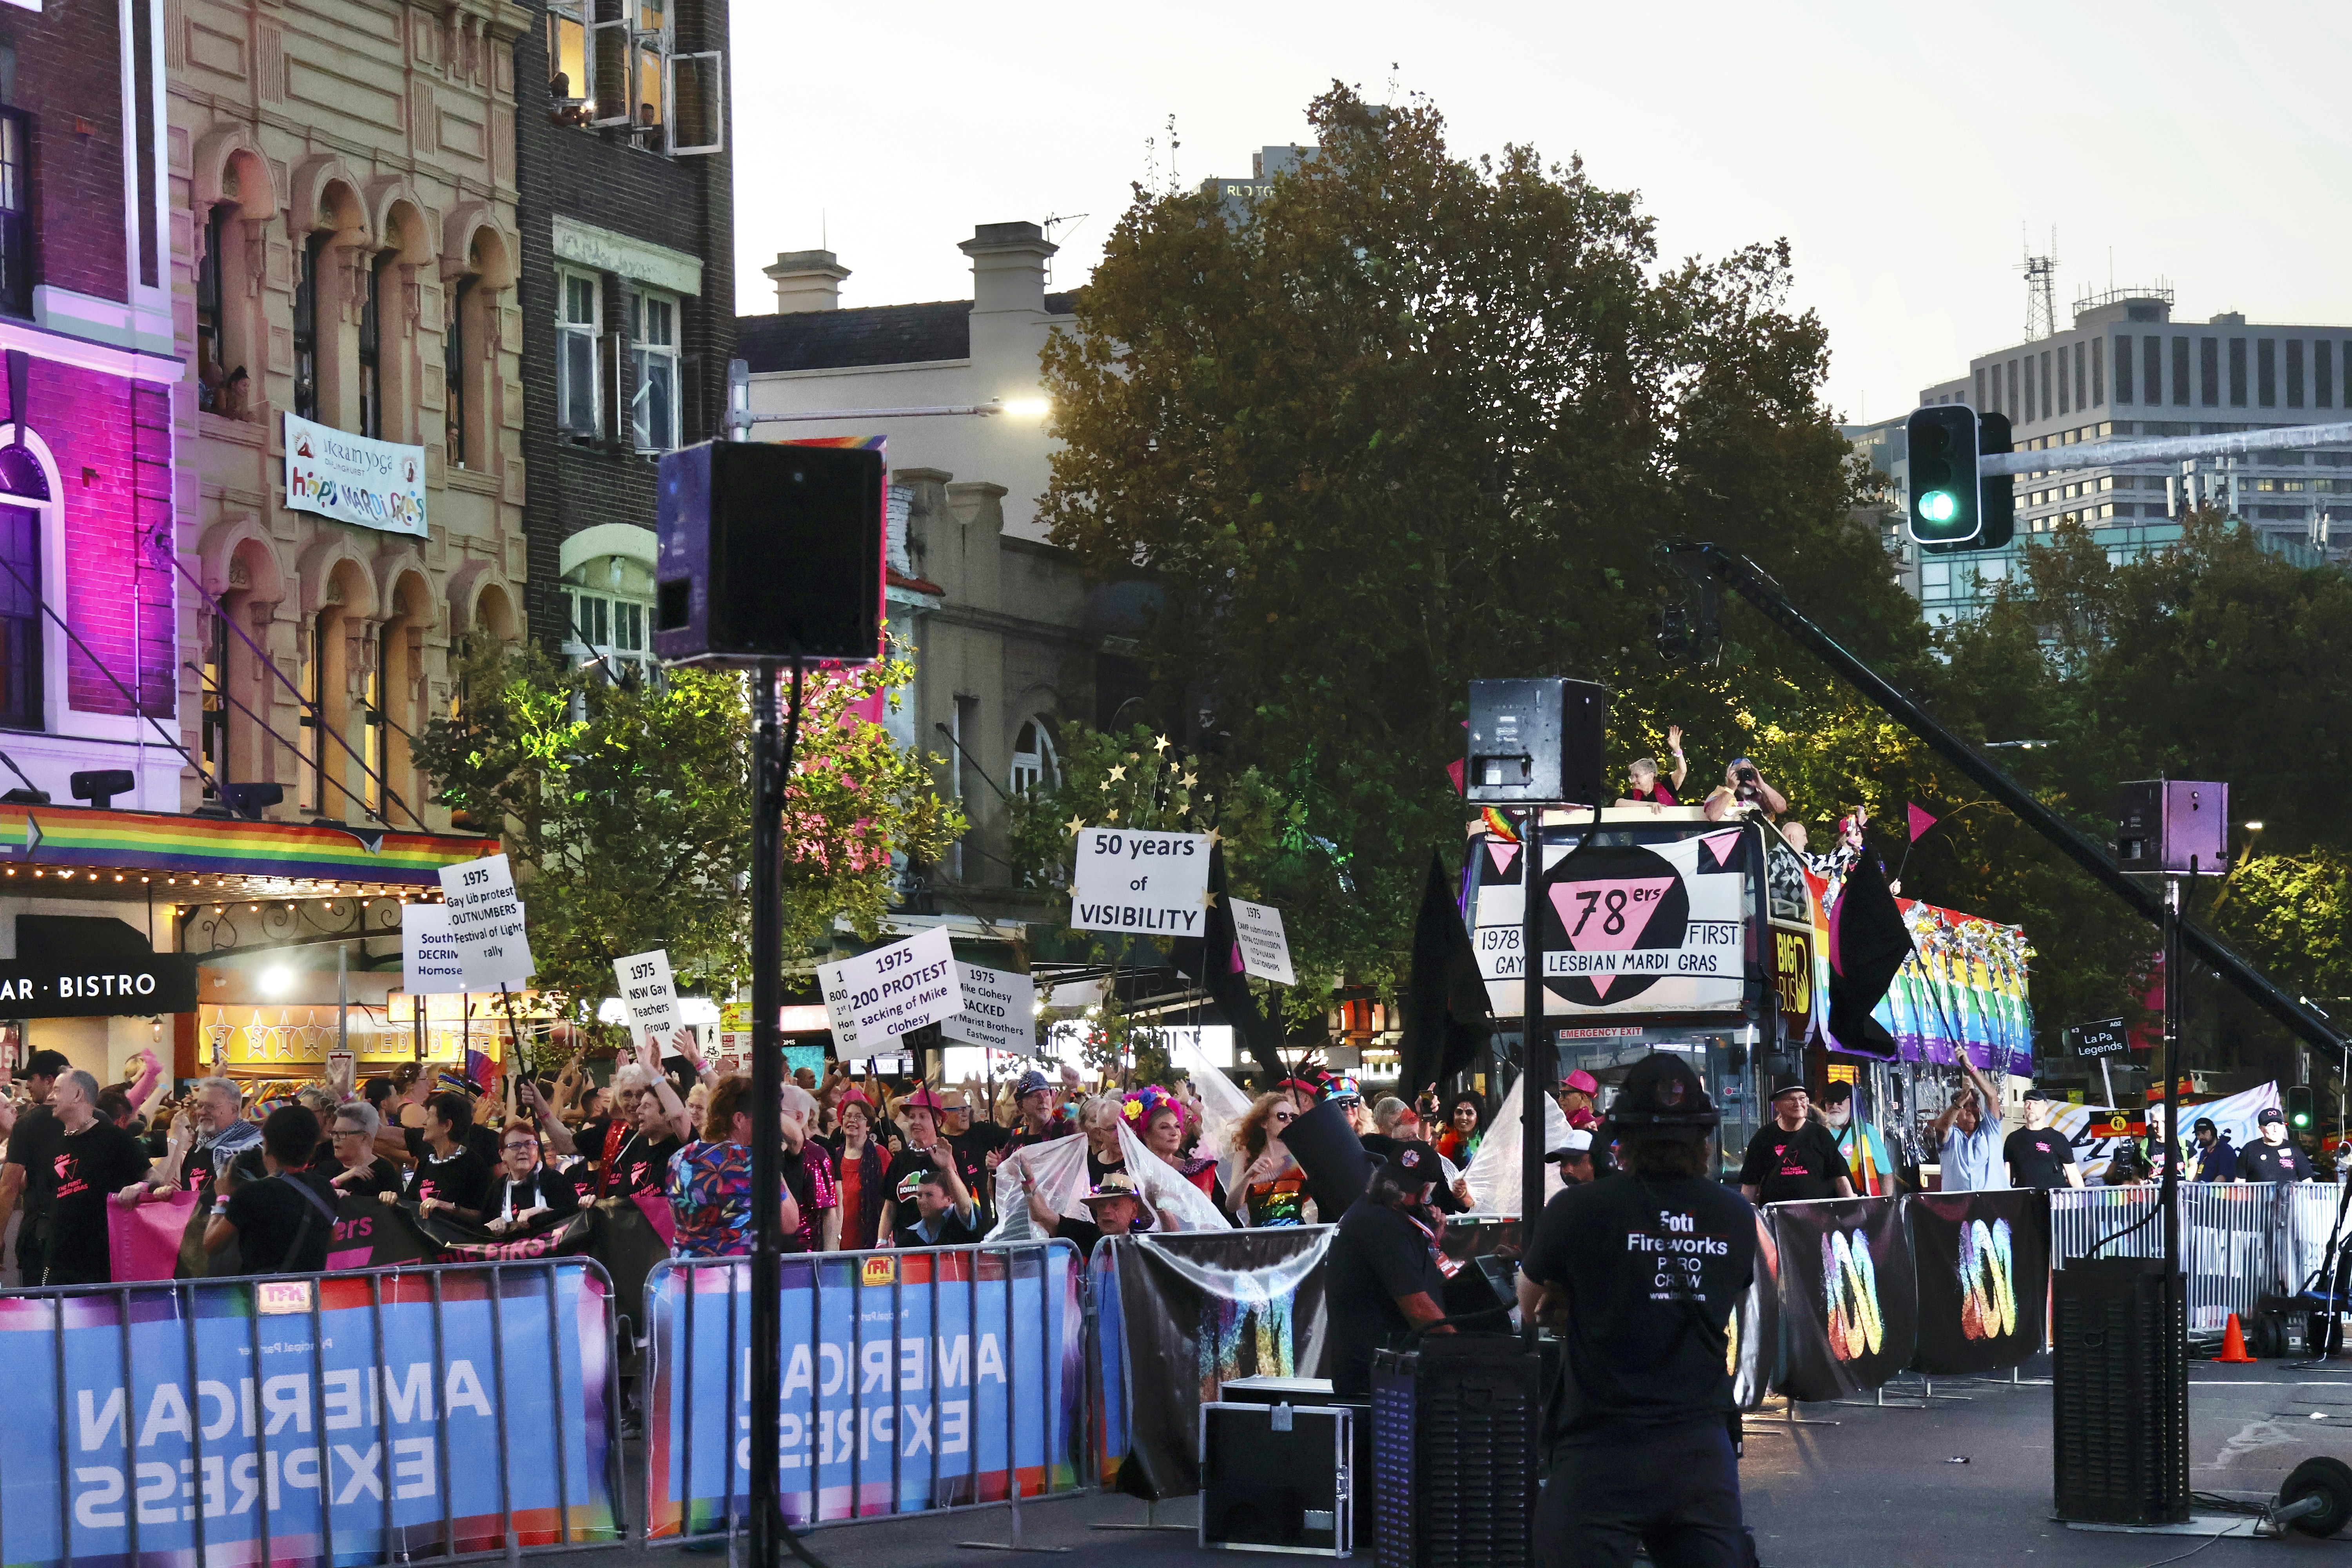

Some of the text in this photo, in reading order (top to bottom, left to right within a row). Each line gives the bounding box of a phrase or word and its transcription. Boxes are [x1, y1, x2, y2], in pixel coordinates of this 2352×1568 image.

[365, 452, 392, 474] yoga
[1095, 835, 1194, 859] 50 years
[463, 869, 488, 886] 1975
[1130, 877, 1148, 891] of
[447, 886, 514, 908] Gay Lib protest
[452, 904, 517, 925] OUTNUMBERS
[1080, 904, 1197, 931] VISIBILITY
[1247, 907, 1260, 919] 1975
[455, 922, 523, 943] Festival of Light
[1238, 922, 1249, 930] CAMP
[1250, 925, 1274, 937] submission
[1482, 925, 1738, 950] 1978 FIRST
[421, 933, 453, 944] South
[1241, 934, 1281, 950] ROYAL COMMISSION
[484, 946, 503, 958] rally
[1259, 950, 1275, 959] HUMAN
[1776, 933, 1795, 973] BIG
[876, 947, 913, 974] 1975
[1251, 957, 1279, 971] RELATIONSHIPS
[1495, 953, 1717, 974] GAY LESBIAN MARDI GRAS
[630, 962, 655, 980] 1975
[970, 969, 995, 983] 1975
[60, 974, 156, 998] BISTRO
[629, 984, 666, 1000] NSW Gay
[851, 960, 947, 1010] 200 PROTEST
[829, 989, 848, 1001] 800
[978, 988, 1012, 1003] Clohesy
[1779, 976, 1796, 1012] BUS
[633, 1003, 669, 1018] Teachers
[836, 1006, 846, 1015] 1st
[862, 987, 947, 1026] sacking of Mike
[963, 998, 1005, 1017] SACKED
[644, 1022, 670, 1033] Group
[887, 1012, 931, 1035] Clohesy
[960, 1014, 984, 1027] Marist
[987, 1021, 1023, 1035] Brothers
[215, 1025, 226, 1049] 5
[967, 1028, 1005, 1044] Eastwood
[1561, 1027, 1641, 1038] EMERGENCY EXIT
[2084, 1033, 2112, 1044] La Pa
[2078, 1041, 2123, 1056] Legends
[58, 1184, 68, 1192] THE
[73, 1183, 88, 1192] GRAS
[641, 1183, 654, 1196] FIRST
[332, 1216, 372, 1240] ers
[1628, 1233, 1728, 1255] Fireworks
[1658, 1257, 1701, 1272] PRO
[1655, 1273, 1701, 1288] CRW
